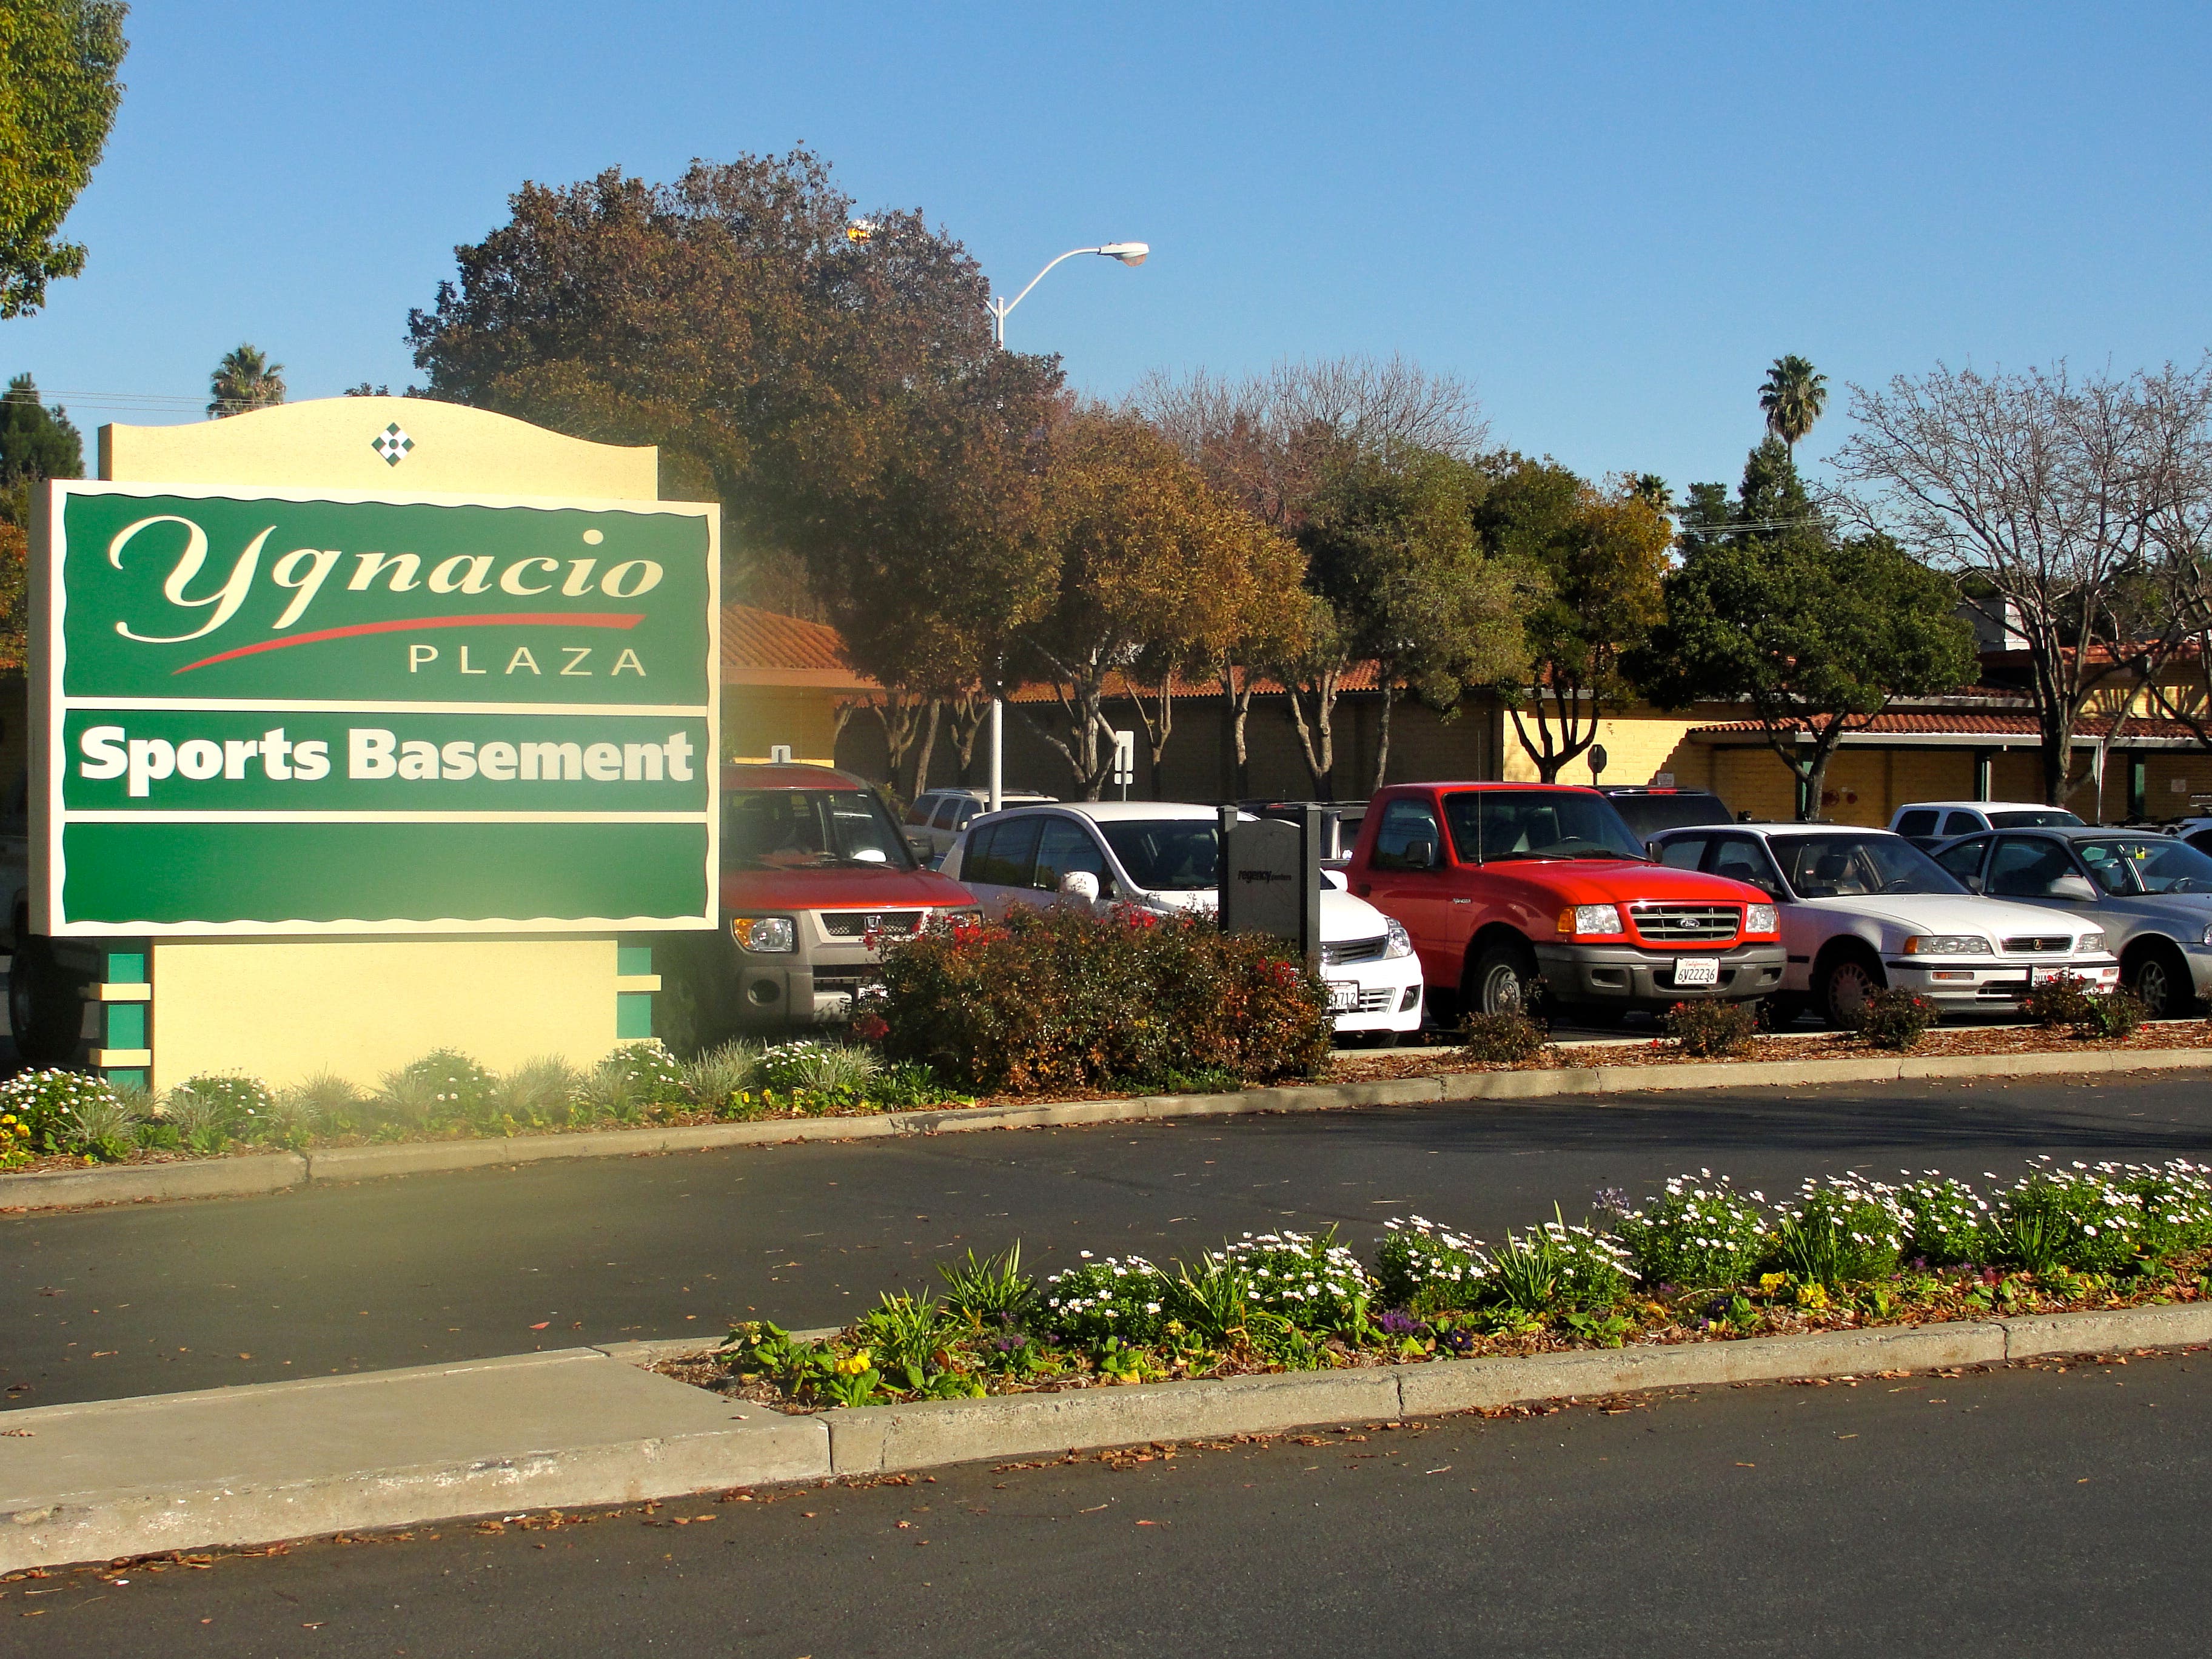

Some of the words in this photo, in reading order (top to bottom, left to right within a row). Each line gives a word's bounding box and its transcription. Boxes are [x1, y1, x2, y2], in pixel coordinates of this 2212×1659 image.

[109, 515, 664, 644] Ygnacio
[409, 643, 646, 676] PLAZA
[81, 726, 331, 797] Sports
[348, 728, 694, 782] Basement
[1238, 870, 1272, 883] regency
[1678, 968, 1715, 980] 6V22236
